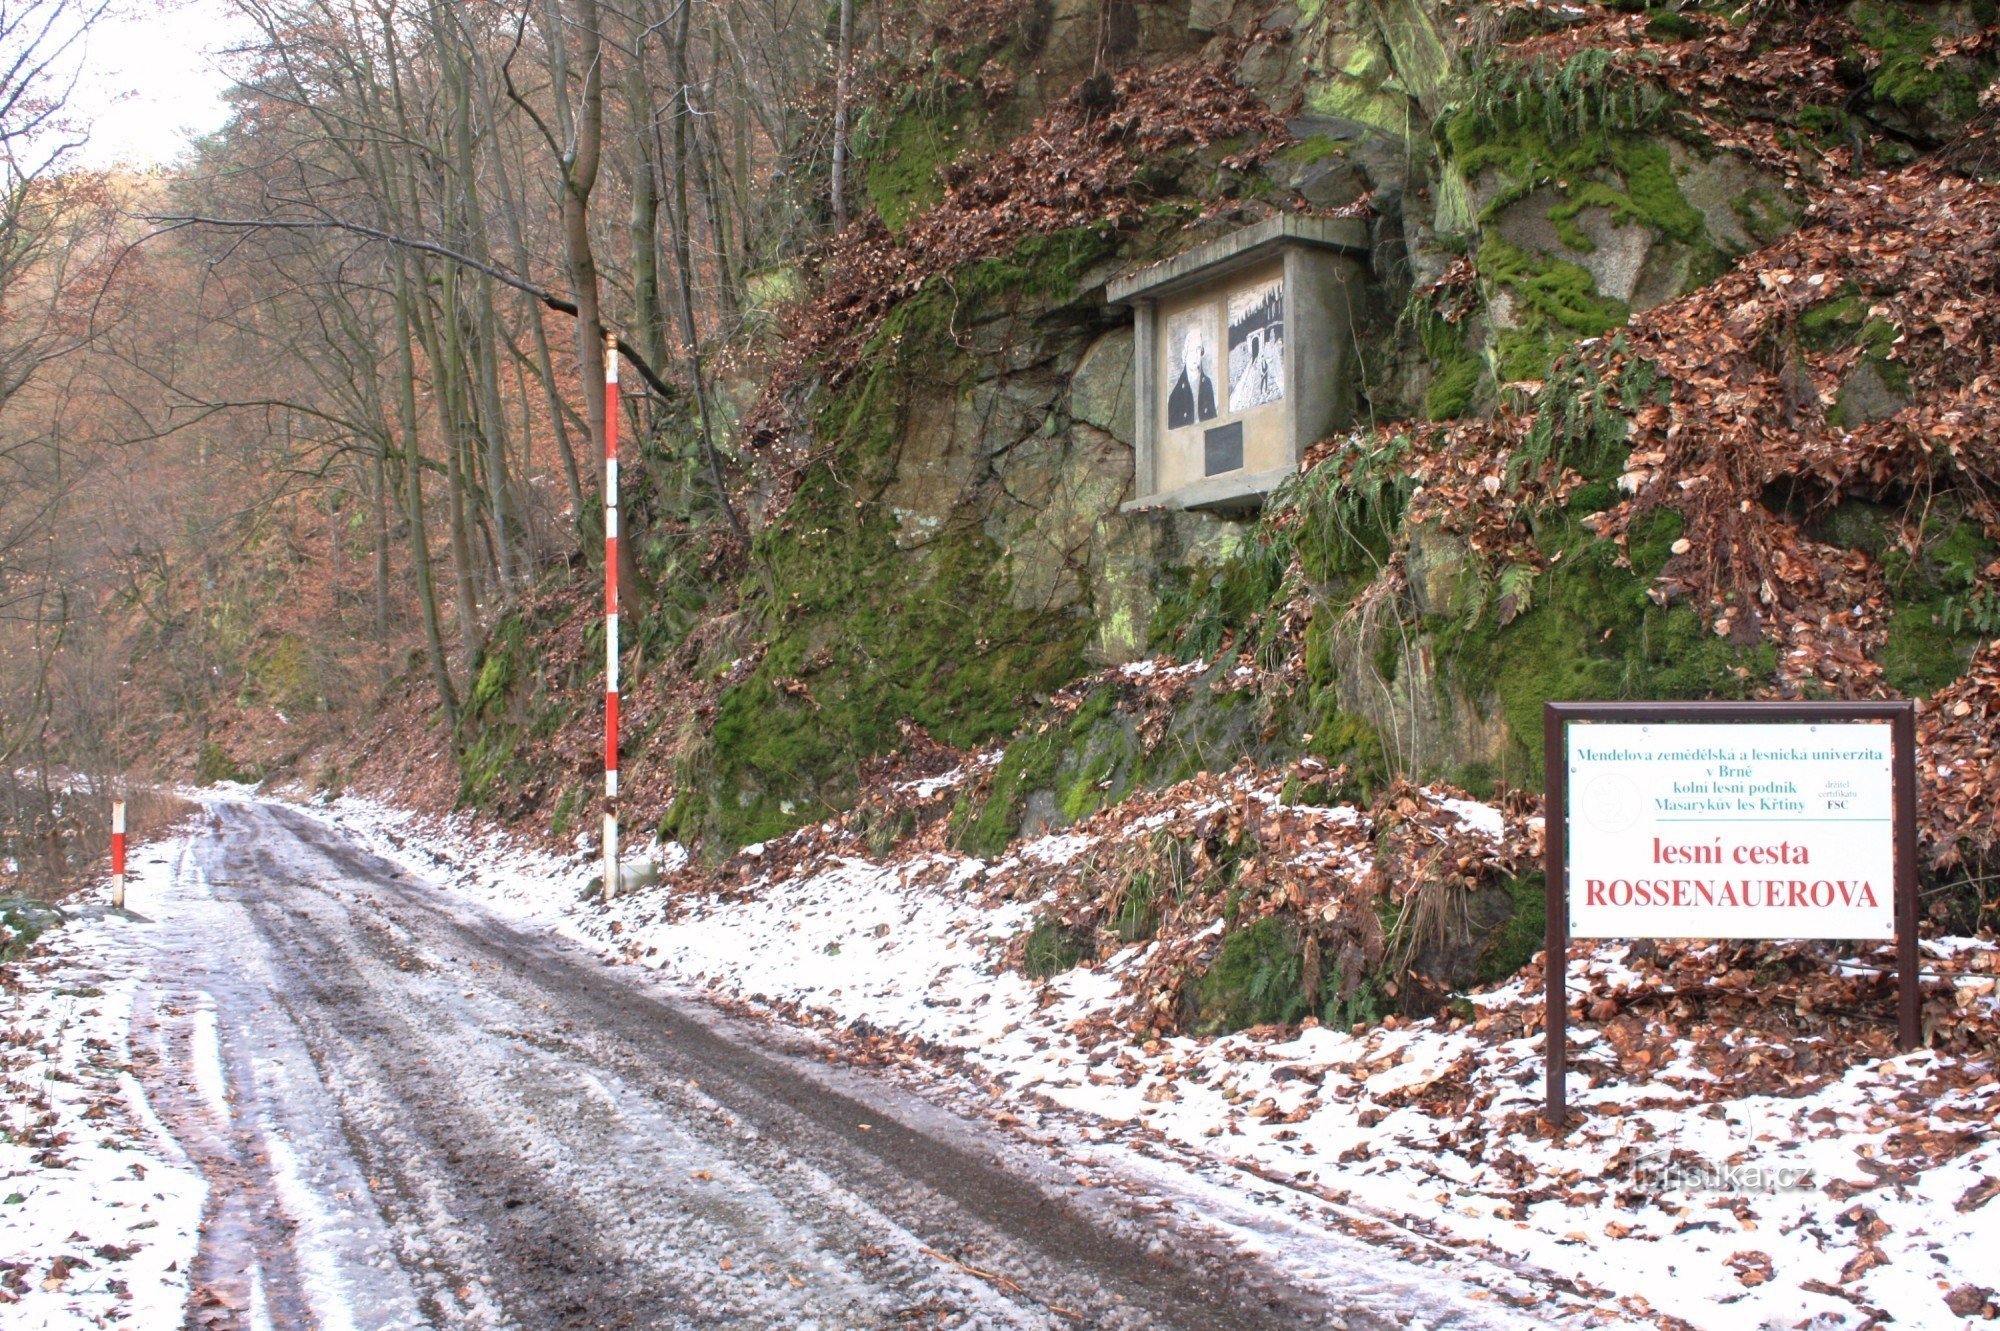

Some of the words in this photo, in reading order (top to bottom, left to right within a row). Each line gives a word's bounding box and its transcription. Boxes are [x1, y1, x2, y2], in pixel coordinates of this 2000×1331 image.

[1577, 748, 1653, 762] Mendelova
[1656, 748, 1736, 761] zemědělská
[1740, 752, 1748, 761] a
[1752, 748, 1808, 761] lesnická
[1812, 748, 1884, 761] univerzita
[1706, 768, 1714, 777] v
[1719, 765, 1753, 778] Brně
[1713, 781, 1745, 794] lesní
[1749, 781, 1798, 797] podnik
[1738, 798, 1755, 811] les
[1760, 797, 1806, 813] Křtiny
[1827, 799, 1849, 810] FSC
[1652, 836, 1722, 865] lesní
[1732, 840, 1811, 865] cesta
[1585, 879, 1879, 908] ROSSENAUEROVA
